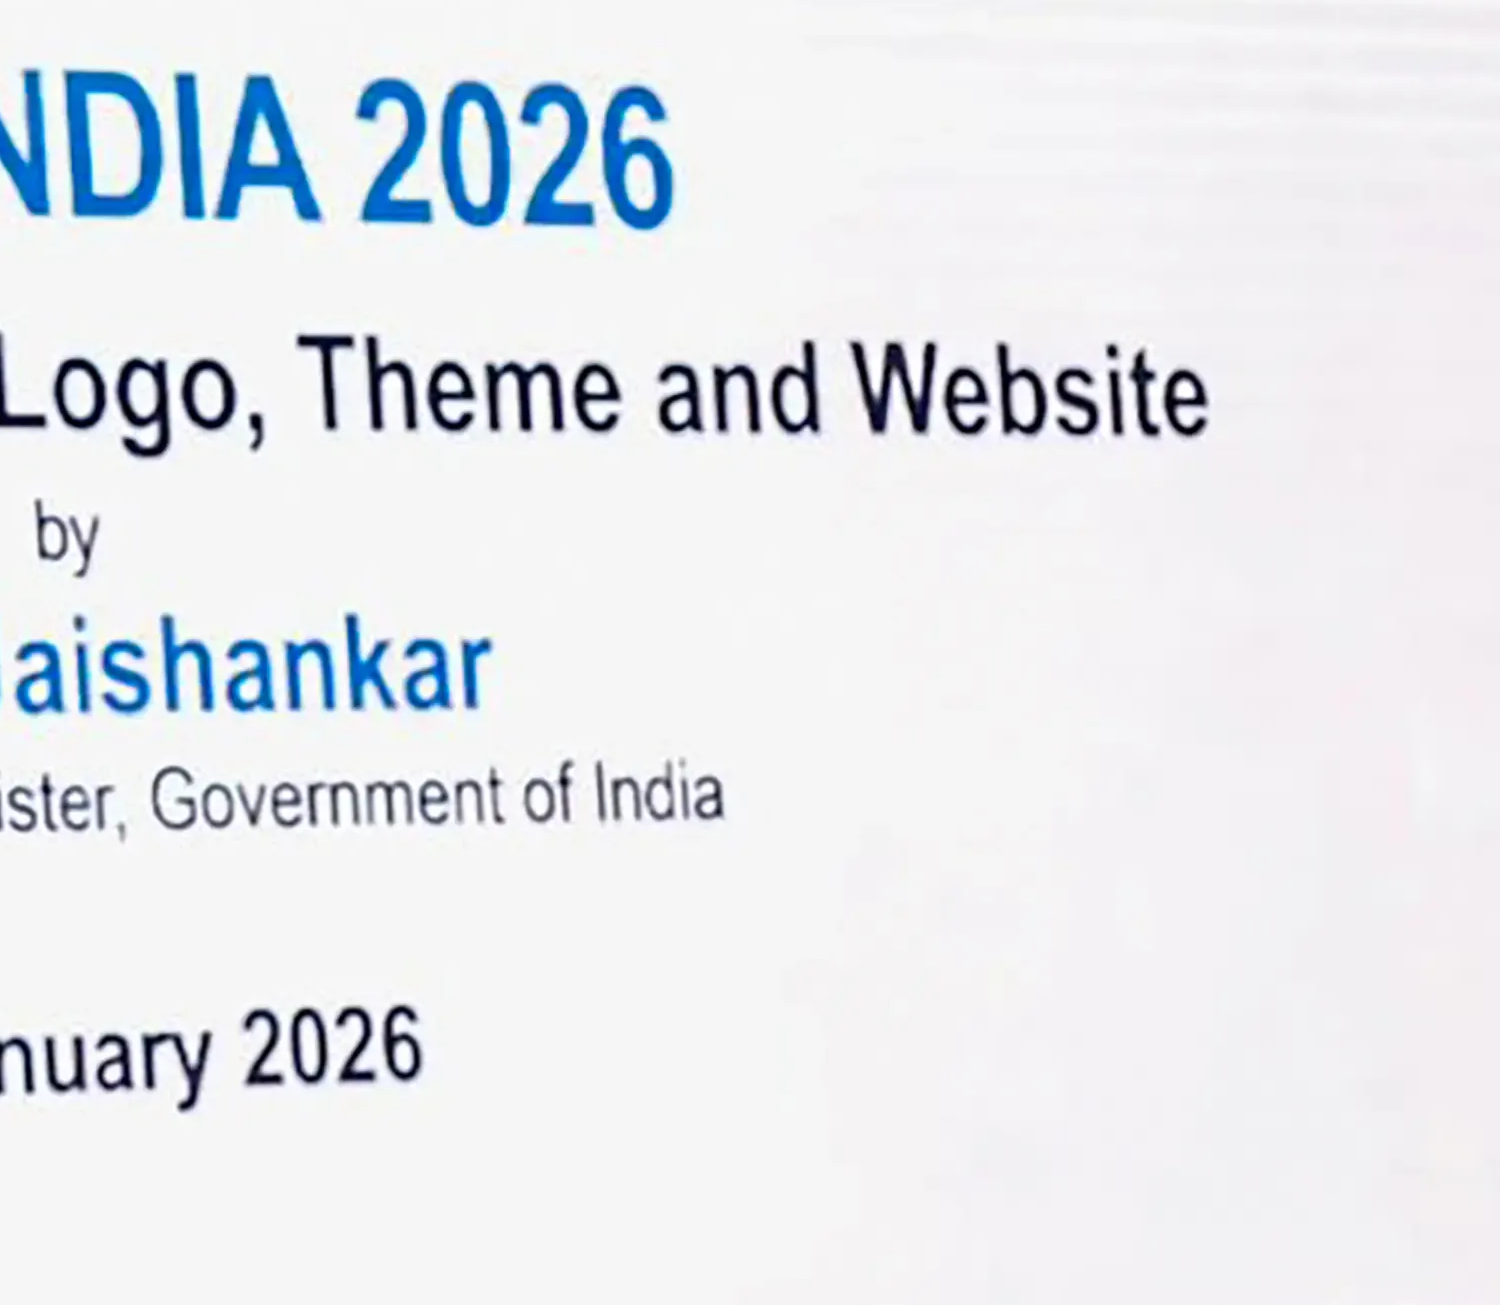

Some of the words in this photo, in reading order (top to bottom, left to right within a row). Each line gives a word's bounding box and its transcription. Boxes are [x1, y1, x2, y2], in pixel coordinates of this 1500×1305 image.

[355, 77, 675, 232] 2026
[296, 333, 622, 435] Theme
[657, 339, 821, 436] and
[848, 340, 1209, 439] Website
[33, 498, 101, 579] by
[150, 763, 505, 832] Government
[522, 758, 575, 825] of
[595, 758, 725, 823] India
[242, 1004, 423, 1087] 2026
